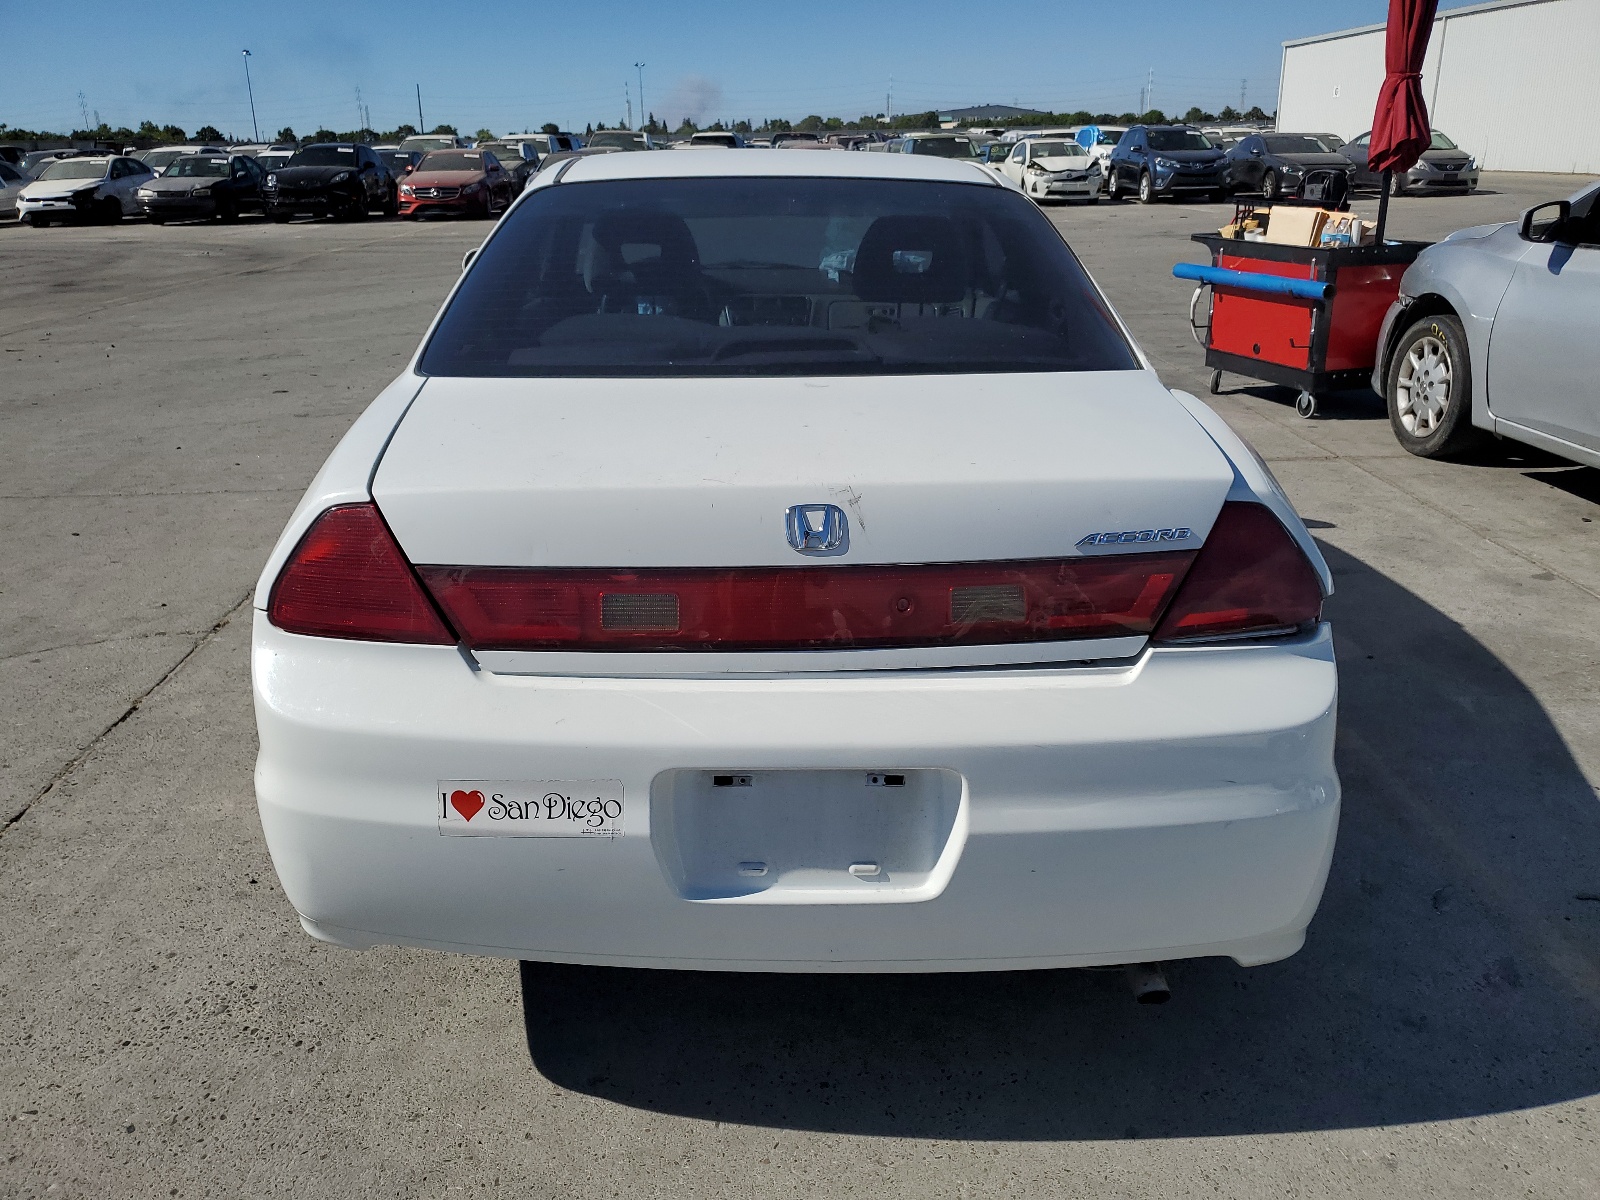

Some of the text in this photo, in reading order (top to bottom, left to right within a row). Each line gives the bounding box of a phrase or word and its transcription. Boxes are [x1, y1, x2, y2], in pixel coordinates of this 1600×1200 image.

[1073, 527, 1191, 546] ACCORD
[441, 792, 622, 827] I San Diego
